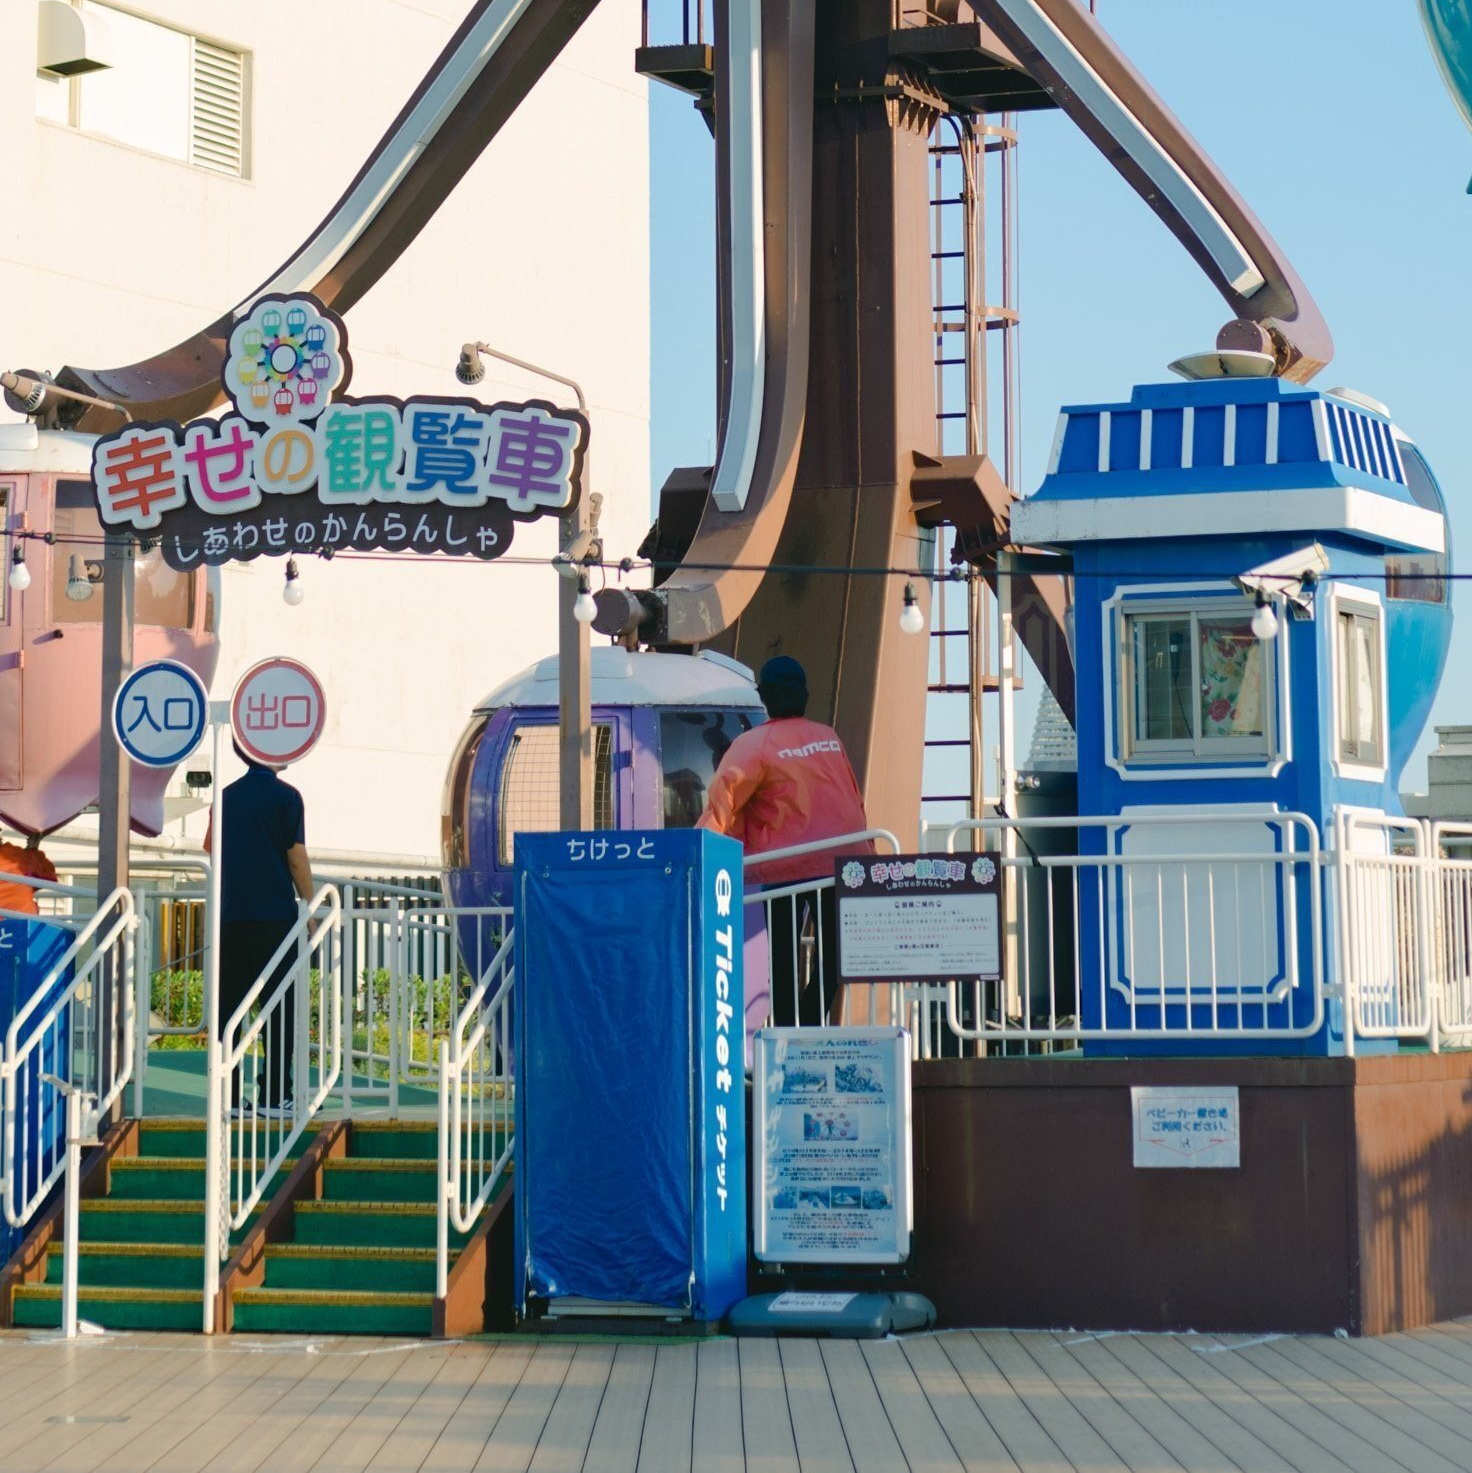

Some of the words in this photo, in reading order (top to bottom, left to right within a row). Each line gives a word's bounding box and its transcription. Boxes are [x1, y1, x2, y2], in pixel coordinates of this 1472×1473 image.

[104, 410, 571, 517] 幸せの観覧車
[175, 512, 499, 563] しあわせのかんらんしゃ
[127, 694, 194, 733] 入口
[245, 692, 312, 731] 出口
[777, 740, 841, 759] namco
[566, 836, 655, 861] ちけっと
[715, 924, 734, 1094] Ticket
[715, 1104, 728, 1212] チケット
